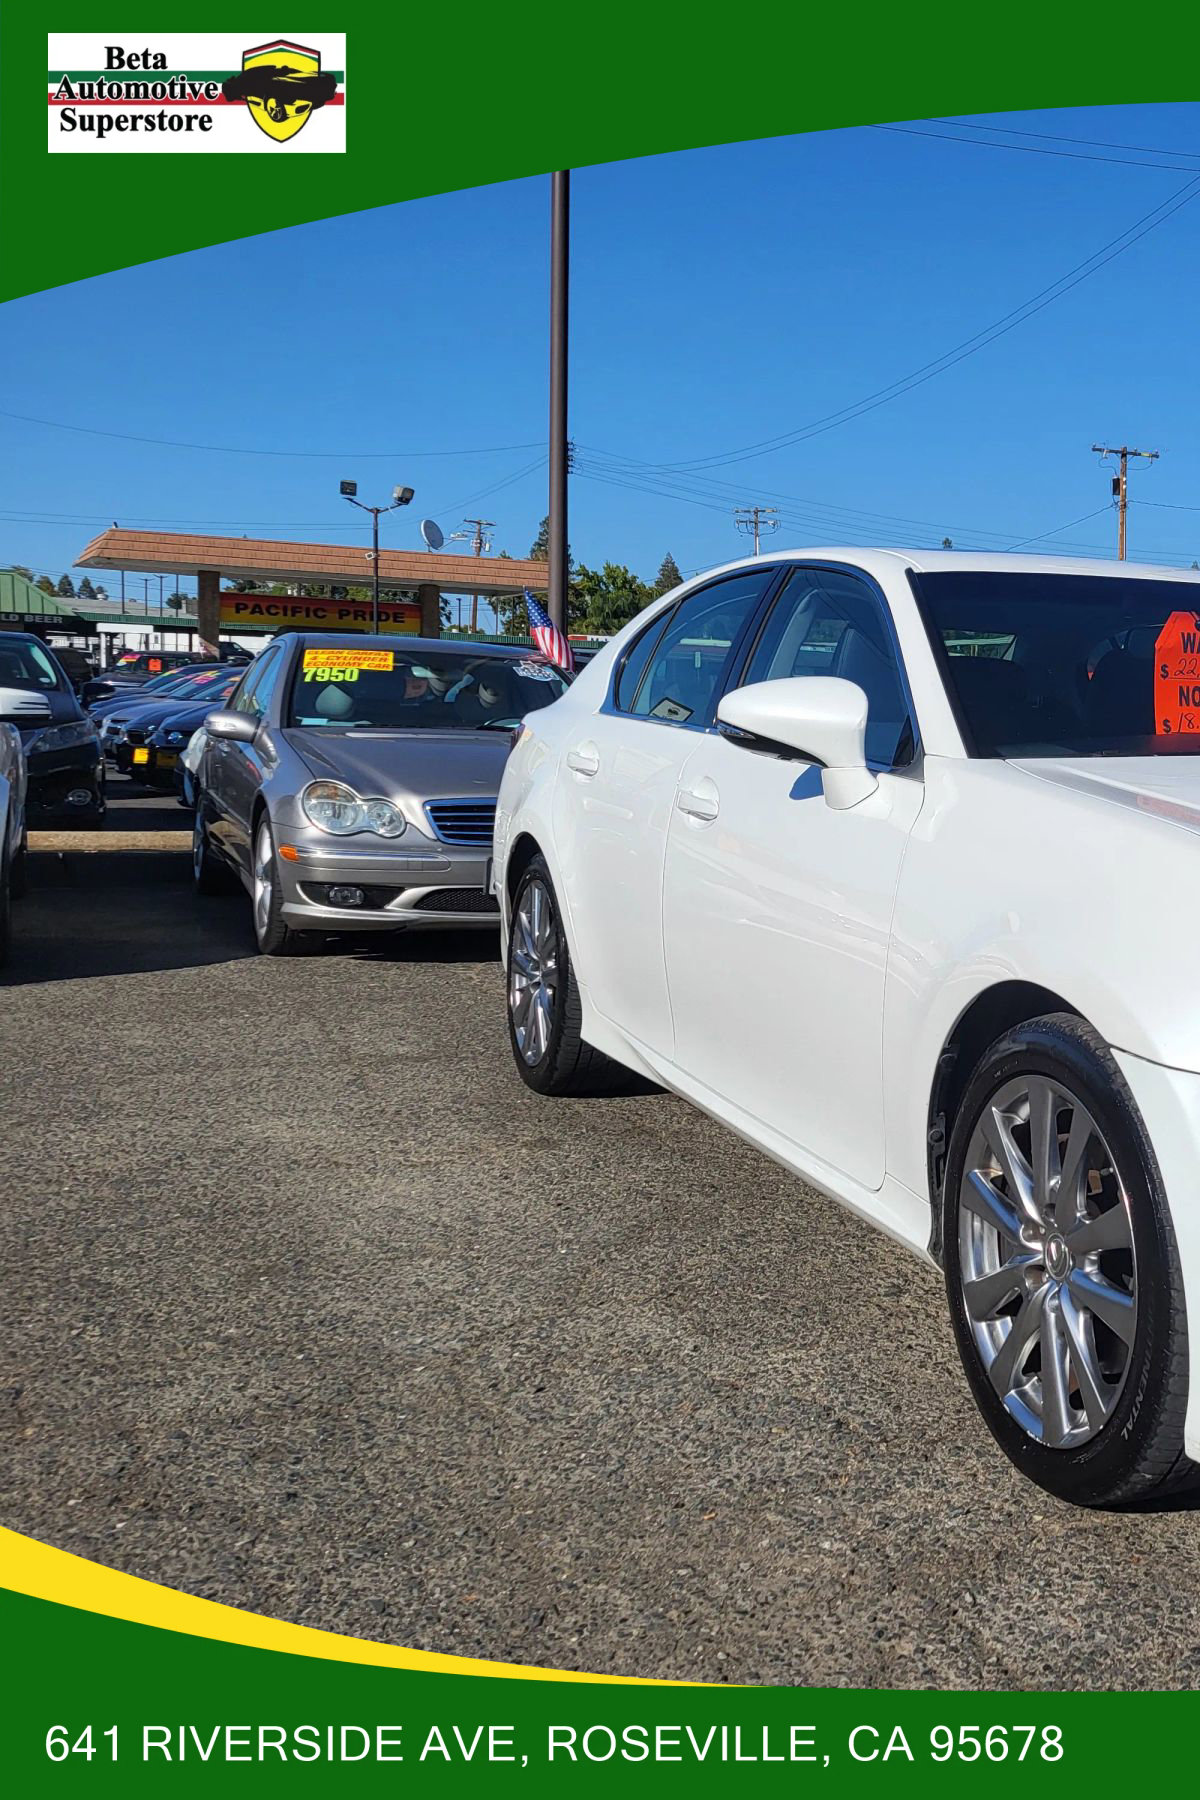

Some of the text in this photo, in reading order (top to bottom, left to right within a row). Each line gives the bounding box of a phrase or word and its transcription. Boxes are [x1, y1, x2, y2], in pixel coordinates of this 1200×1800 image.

[24, 615, 63, 624] BEER
[234, 602, 405, 623] PACIFIC PRIDE
[303, 668, 359, 682] 7950
